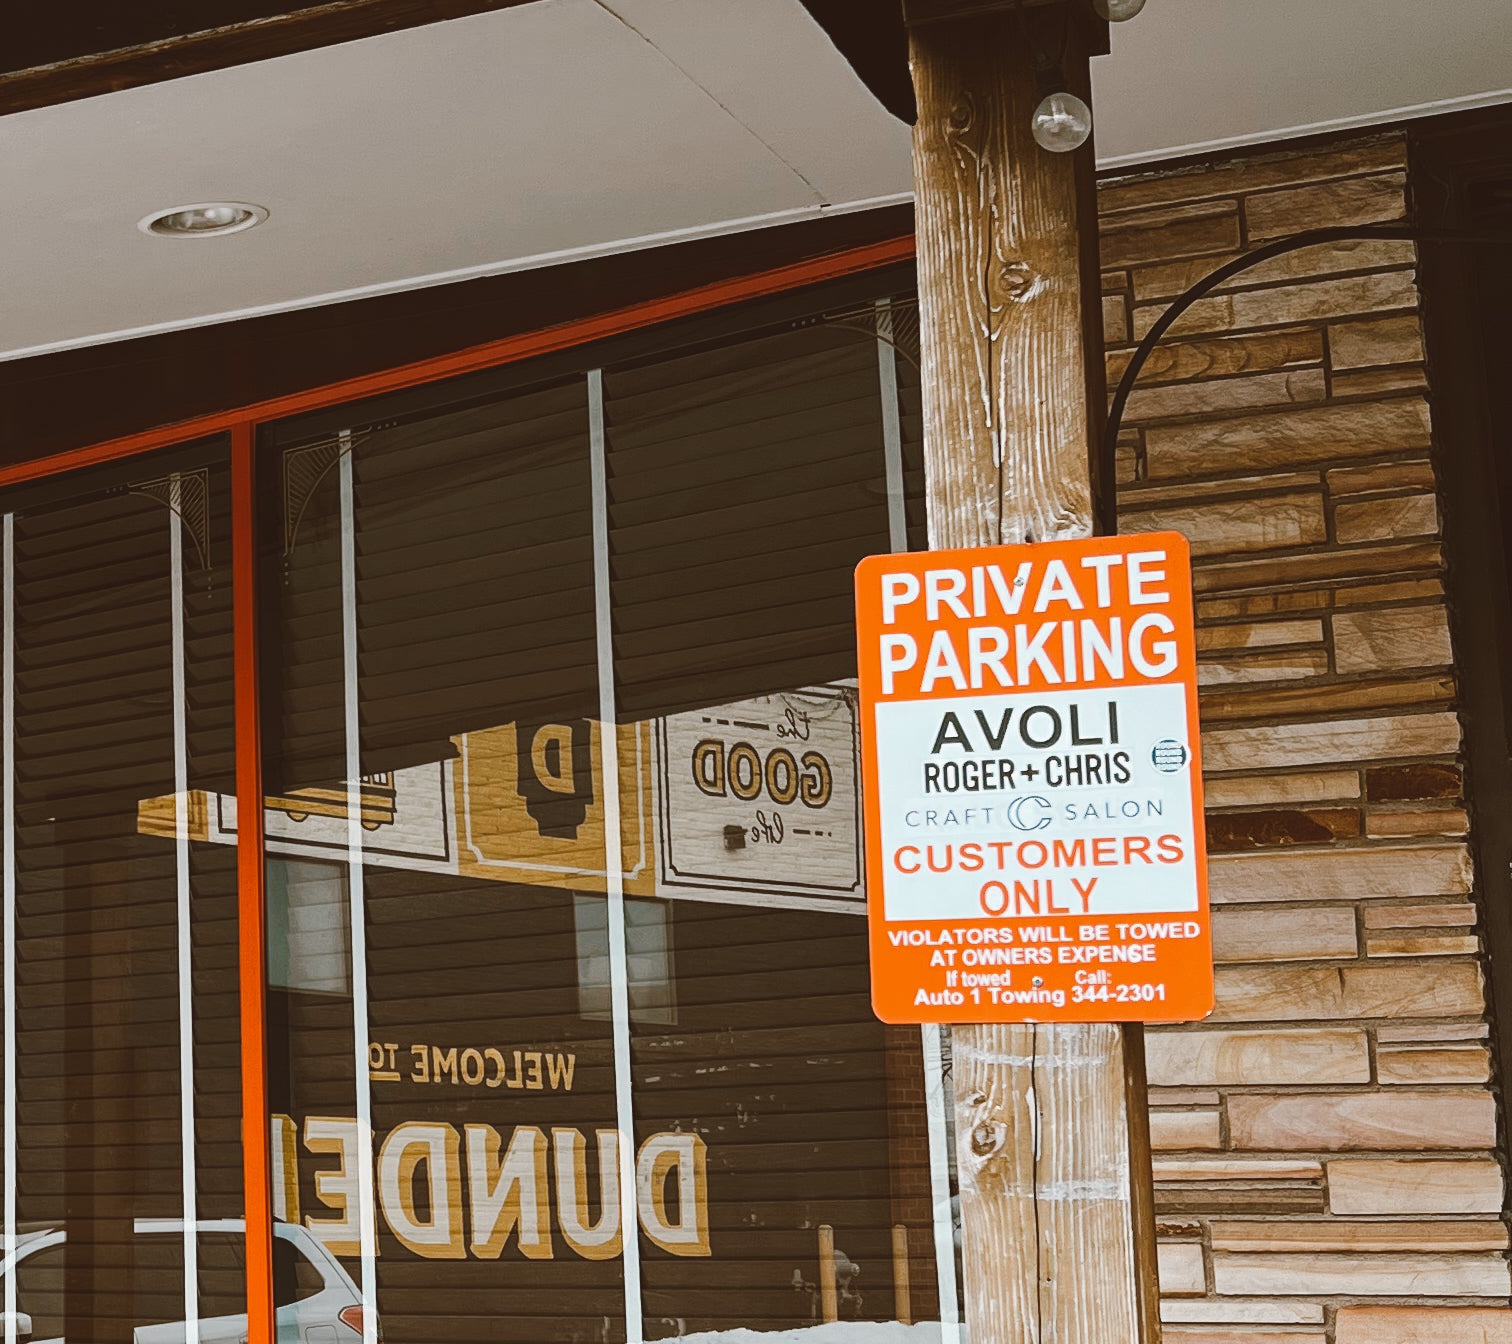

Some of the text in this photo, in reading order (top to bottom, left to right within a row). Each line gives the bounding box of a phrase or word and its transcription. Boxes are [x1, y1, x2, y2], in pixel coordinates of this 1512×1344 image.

[881, 550, 1171, 625] PRIVATE
[879, 612, 1179, 695] PARKING
[931, 701, 1120, 755] AVOLI
[905, 807, 995, 827] CRAFT
[1065, 799, 1163, 821] SALON
[893, 834, 1184, 875] CUSTOMERS
[979, 877, 1098, 916] ONLY
[888, 921, 1201, 947] VIOLATORS WILL BE TOWED
[930, 943, 1157, 966] AT OWNERS EXPENSE
[946, 969, 1112, 988] If towed Call:
[914, 983, 1166, 1008] Auto 1 Towing 344-2301
